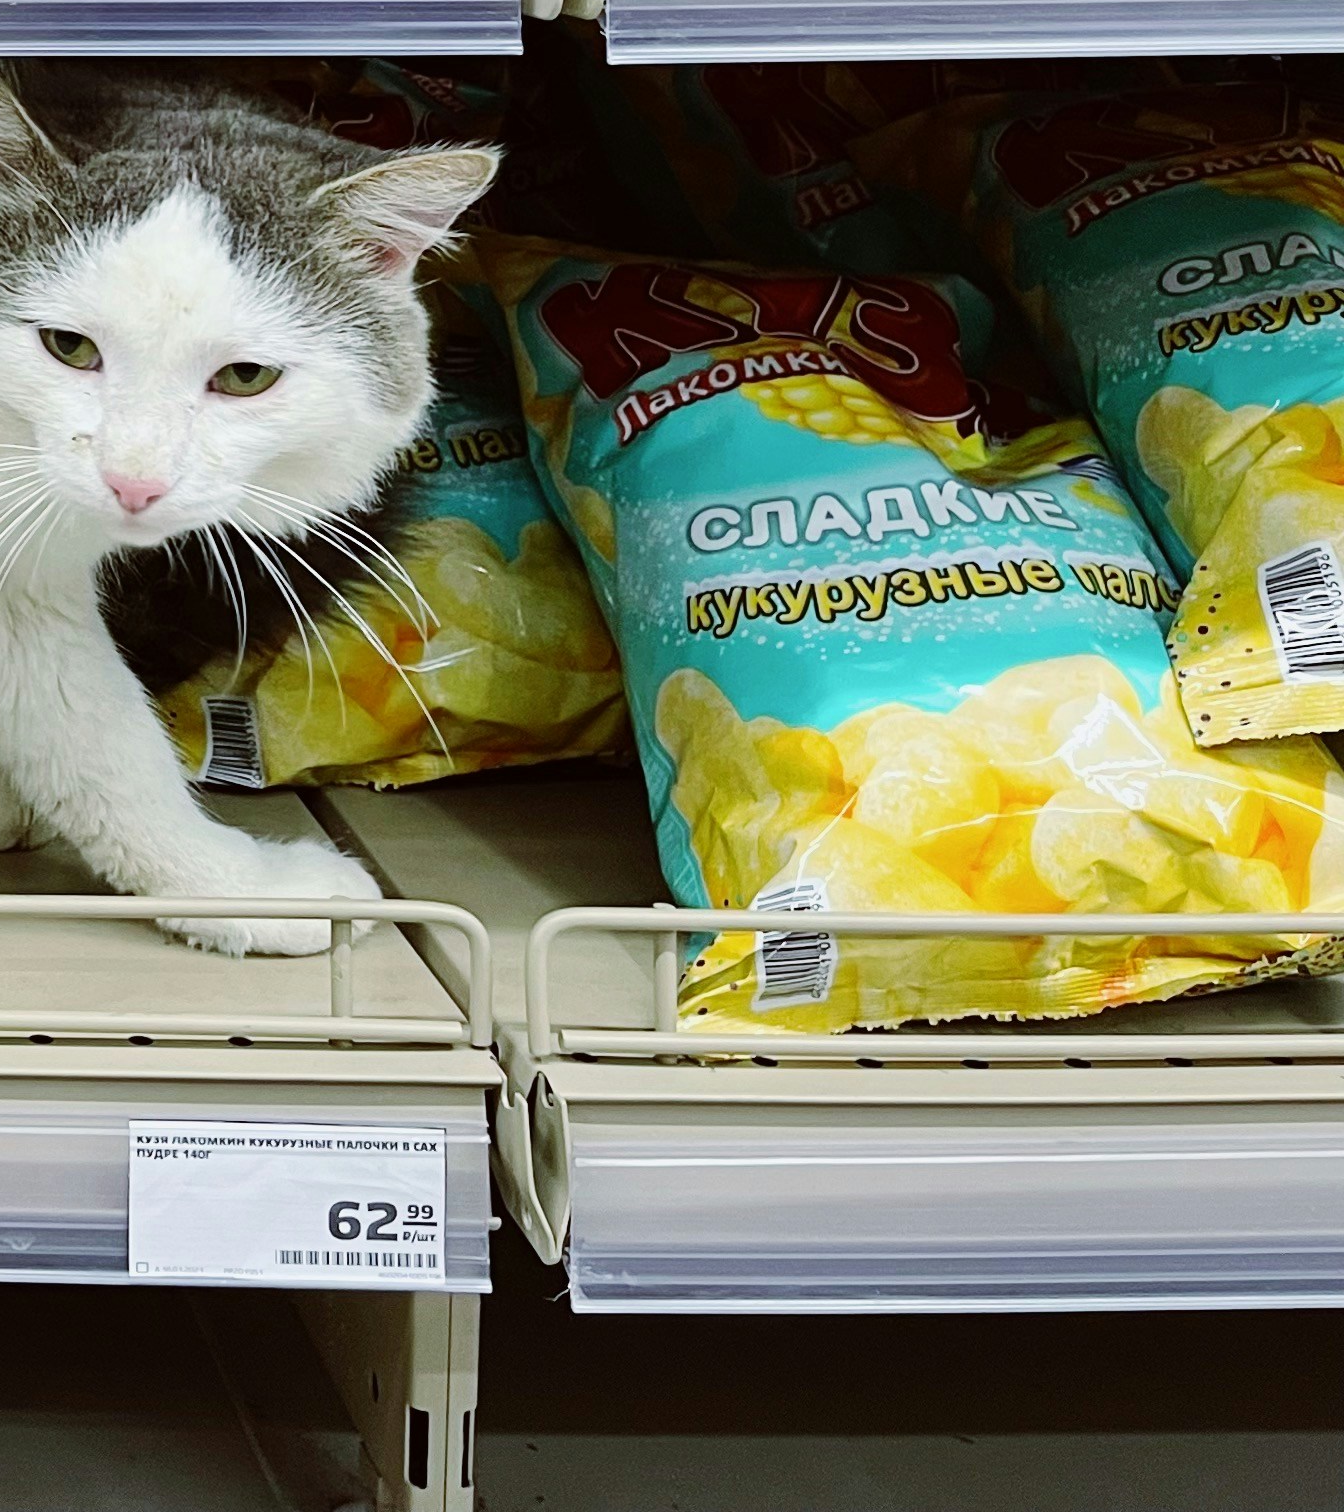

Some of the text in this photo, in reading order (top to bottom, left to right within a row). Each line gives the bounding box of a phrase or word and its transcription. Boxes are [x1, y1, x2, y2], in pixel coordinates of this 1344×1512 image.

[614, 349, 850, 446] Лакомки
[685, 556, 1064, 639] кукурузные
[136, 1135, 438, 1153] КУЗЯ ЛАКОМКИН КУКУРУЗНЫЕ ПАЛОЧКИ В САХ
[136, 1148, 213, 1160] ПУДРЕ 140Г
[327, 1200, 434, 1242] 62 99
